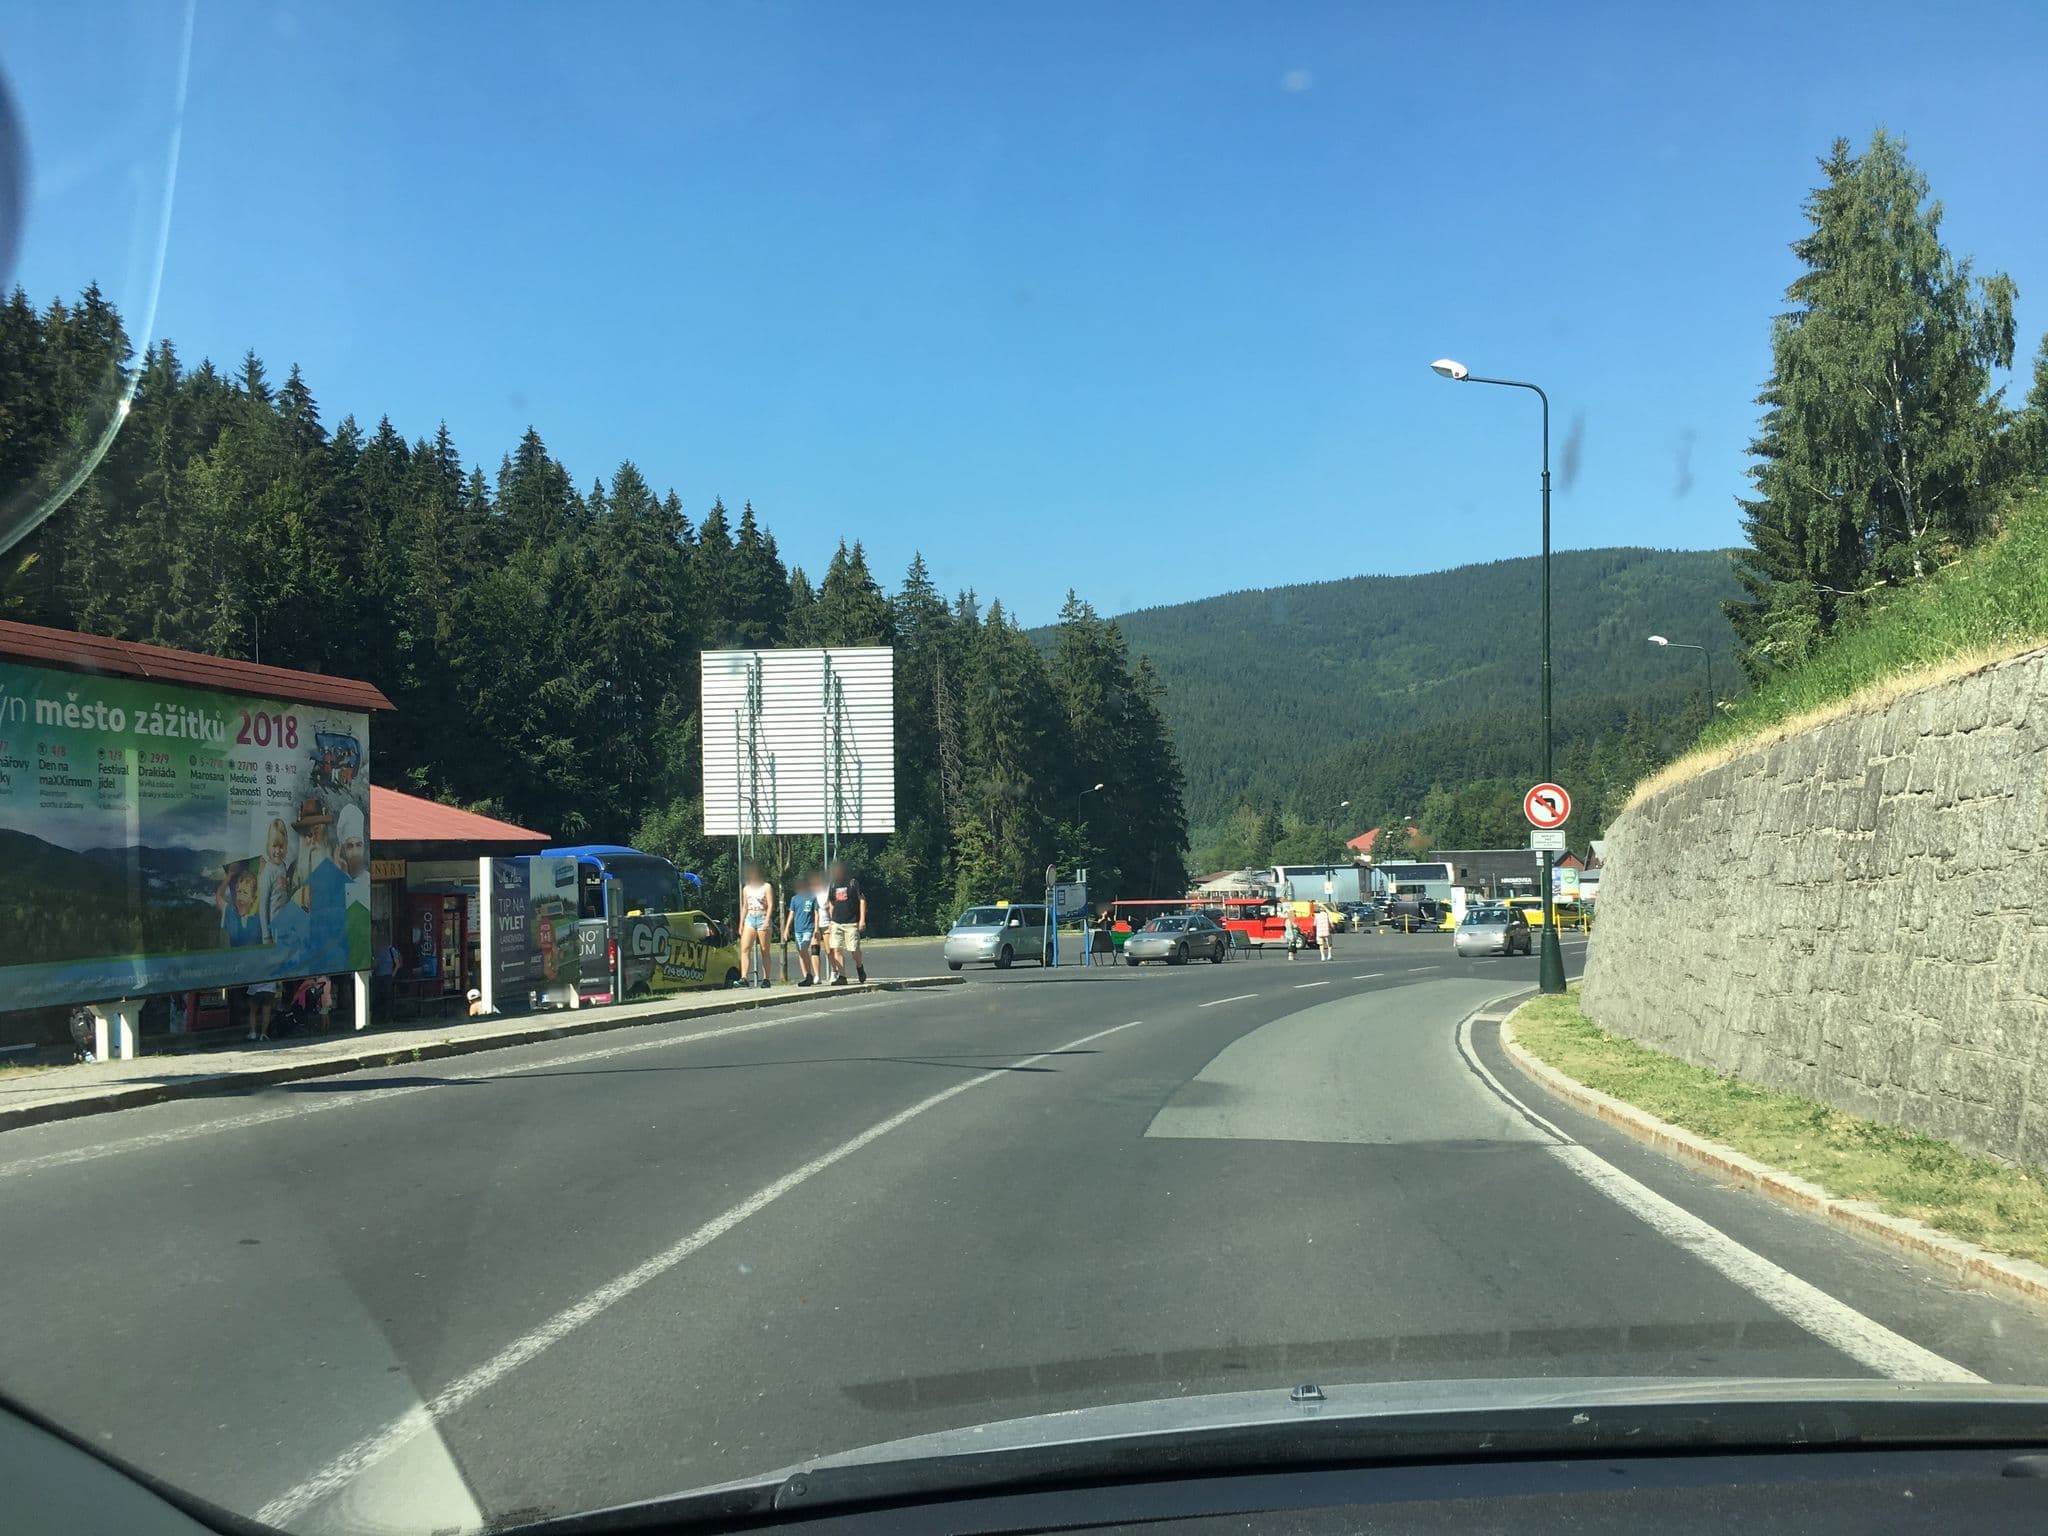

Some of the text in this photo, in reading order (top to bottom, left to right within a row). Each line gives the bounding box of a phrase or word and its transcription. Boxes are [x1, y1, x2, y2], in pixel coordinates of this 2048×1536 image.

[35, 691, 126, 732] město
[134, 703, 226, 743] zážitků
[236, 709, 299, 750] 2018
[39, 758, 69, 772] Den na
[98, 763, 129, 776] Festival
[230, 786, 261, 797] slavnosti
[266, 787, 292, 801] Opening
[498, 896, 526, 913] TIP NA
[498, 913, 525, 931] VÝLET
[632, 923, 707, 970] GO TAXI
